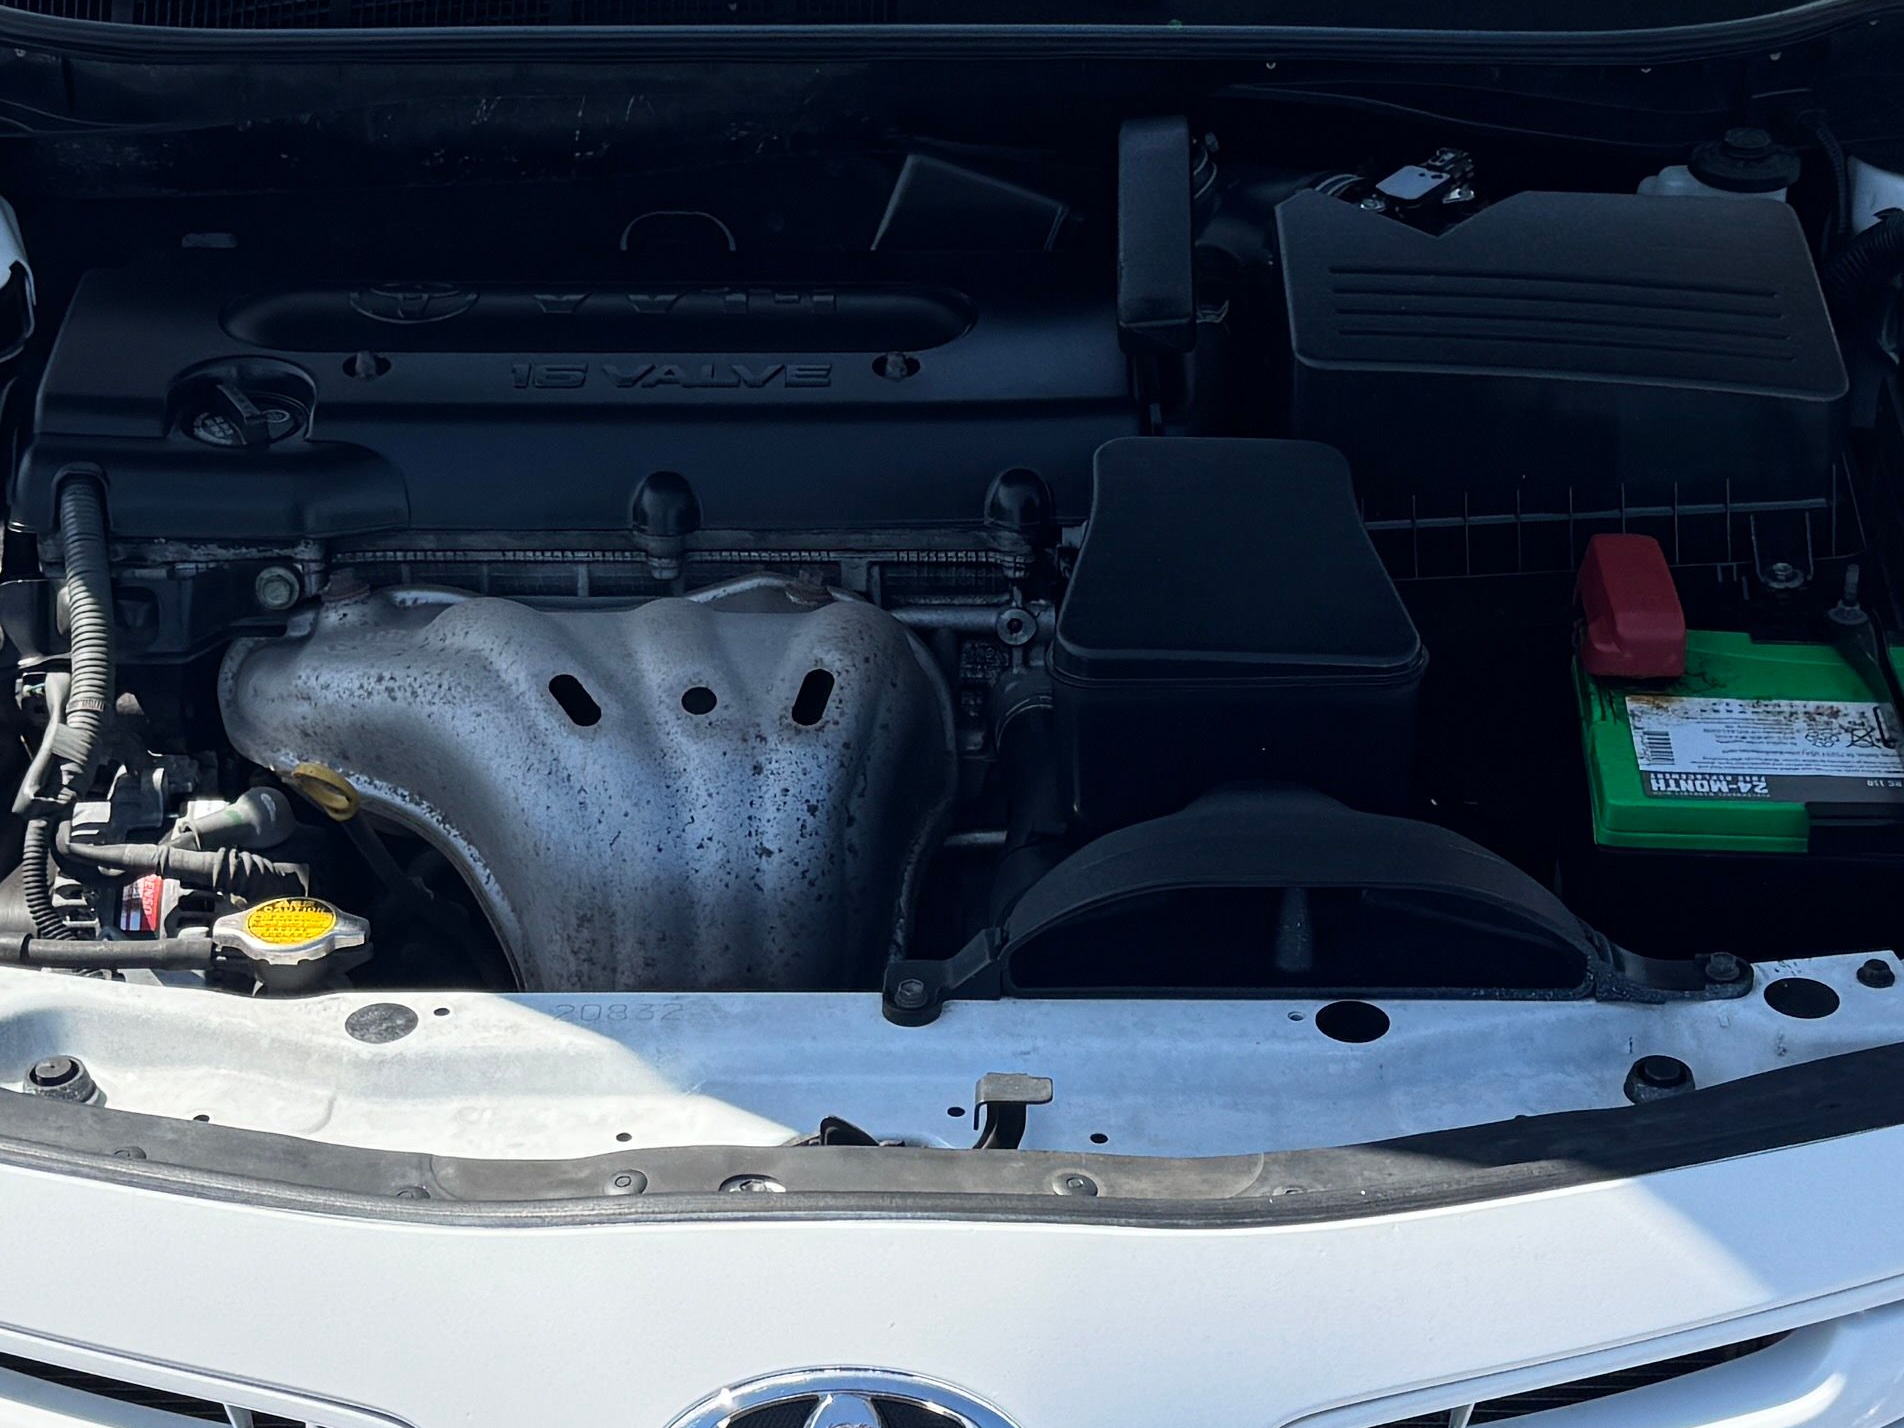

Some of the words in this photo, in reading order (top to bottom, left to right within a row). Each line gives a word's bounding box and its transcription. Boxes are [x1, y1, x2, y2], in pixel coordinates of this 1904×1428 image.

[510, 362, 590, 389] 16
[600, 362, 834, 390] VALVE
[1650, 778, 1769, 794] 24-MONTH
[553, 1003, 684, 1022] 20832
